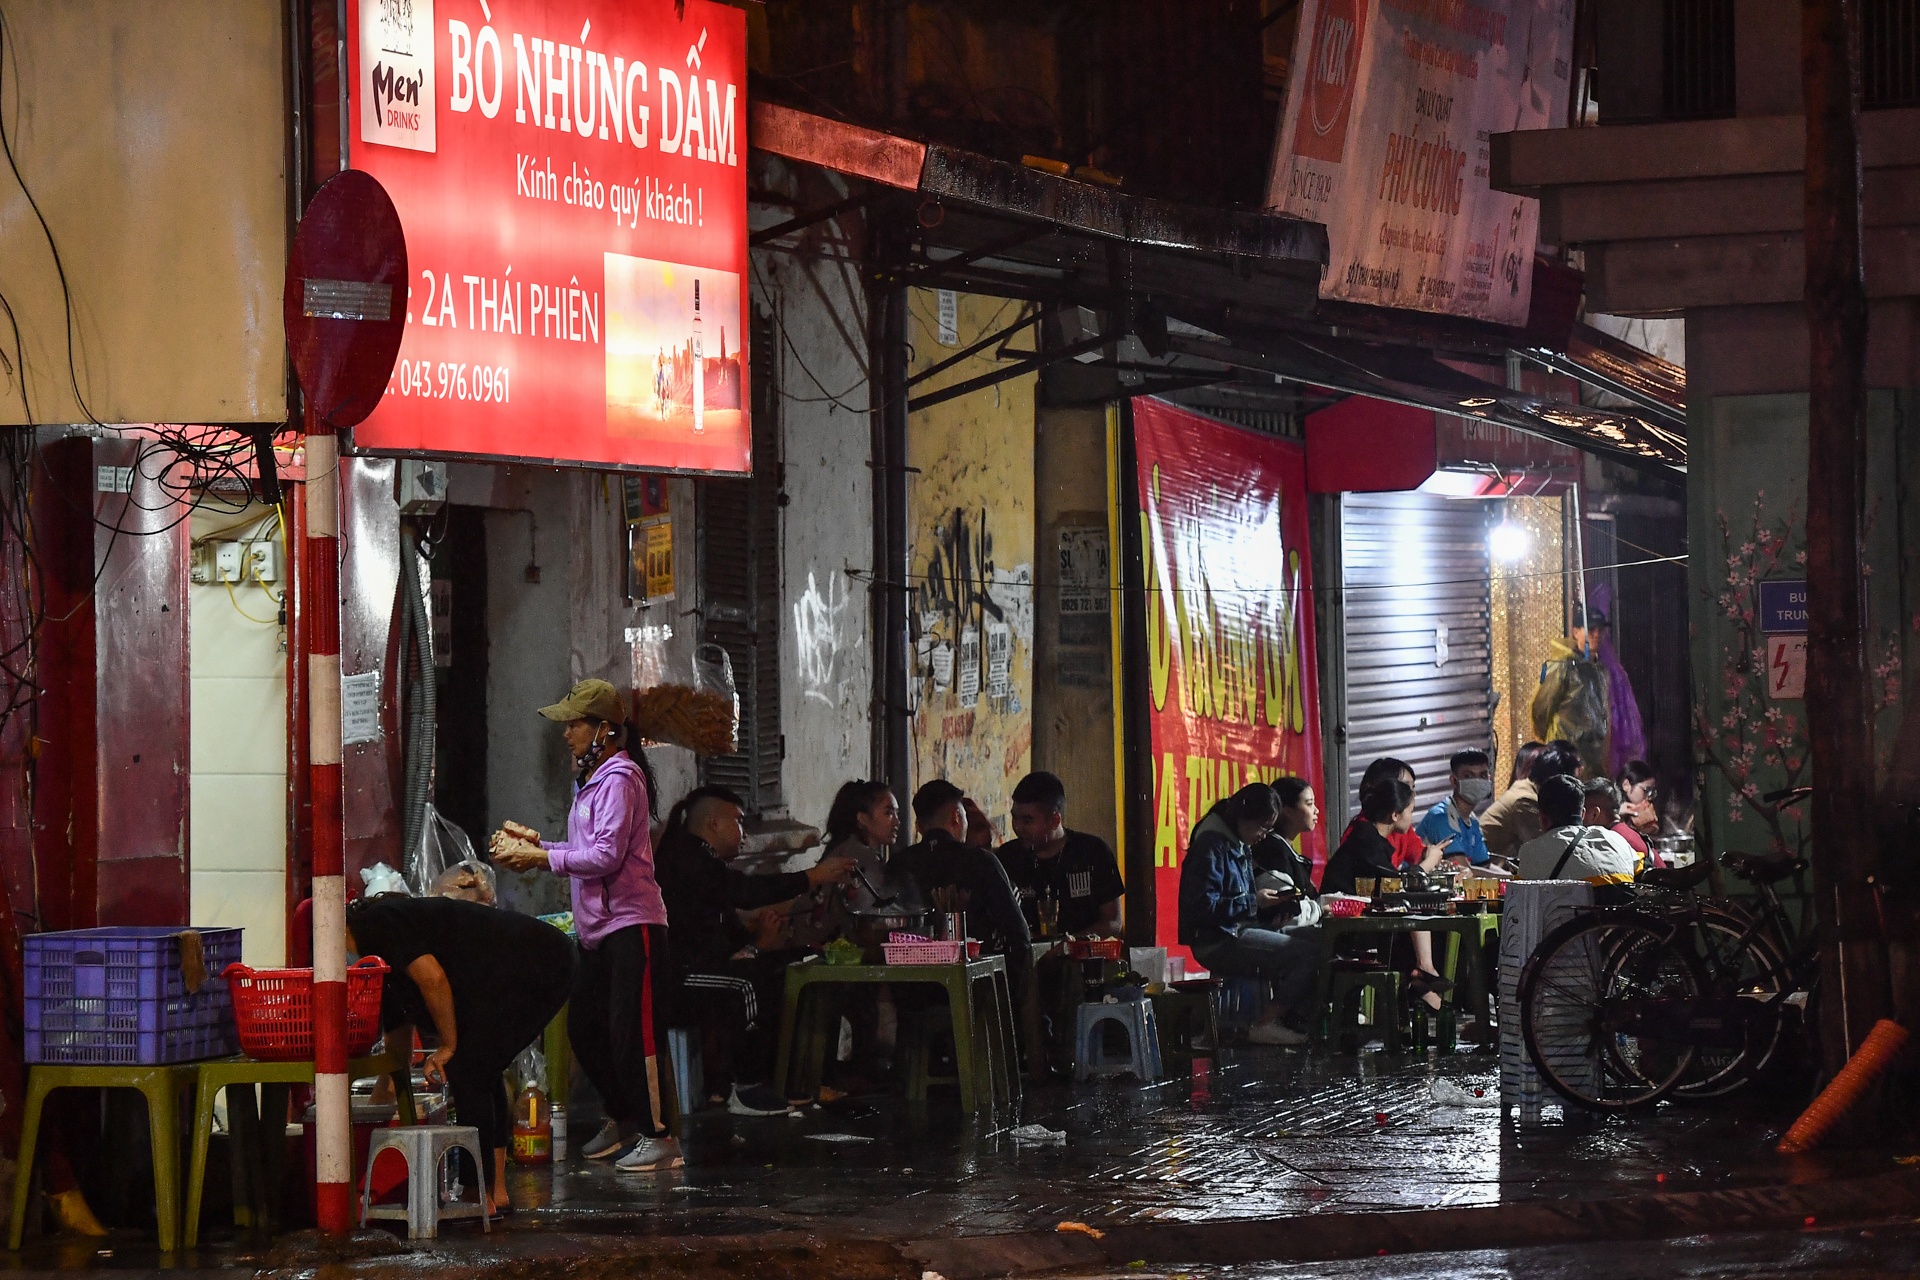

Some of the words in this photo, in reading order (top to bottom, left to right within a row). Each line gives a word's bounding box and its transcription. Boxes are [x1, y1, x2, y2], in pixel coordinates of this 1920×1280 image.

[387, 109, 419, 131] DRINKS
[448, 0, 502, 119] BÒ
[513, 18, 650, 149] NHÚNG
[658, 27, 738, 167] DẤM
[516, 153, 557, 202] Kính
[563, 161, 604, 210] chào
[610, 176, 641, 229] quý
[645, 176, 693, 226] khách
[421, 269, 457, 329] 2A
[462, 264, 522, 334] THÁI
[530, 275, 599, 344] PHIÊN
[400, 359, 510, 404] 043.976.0961
